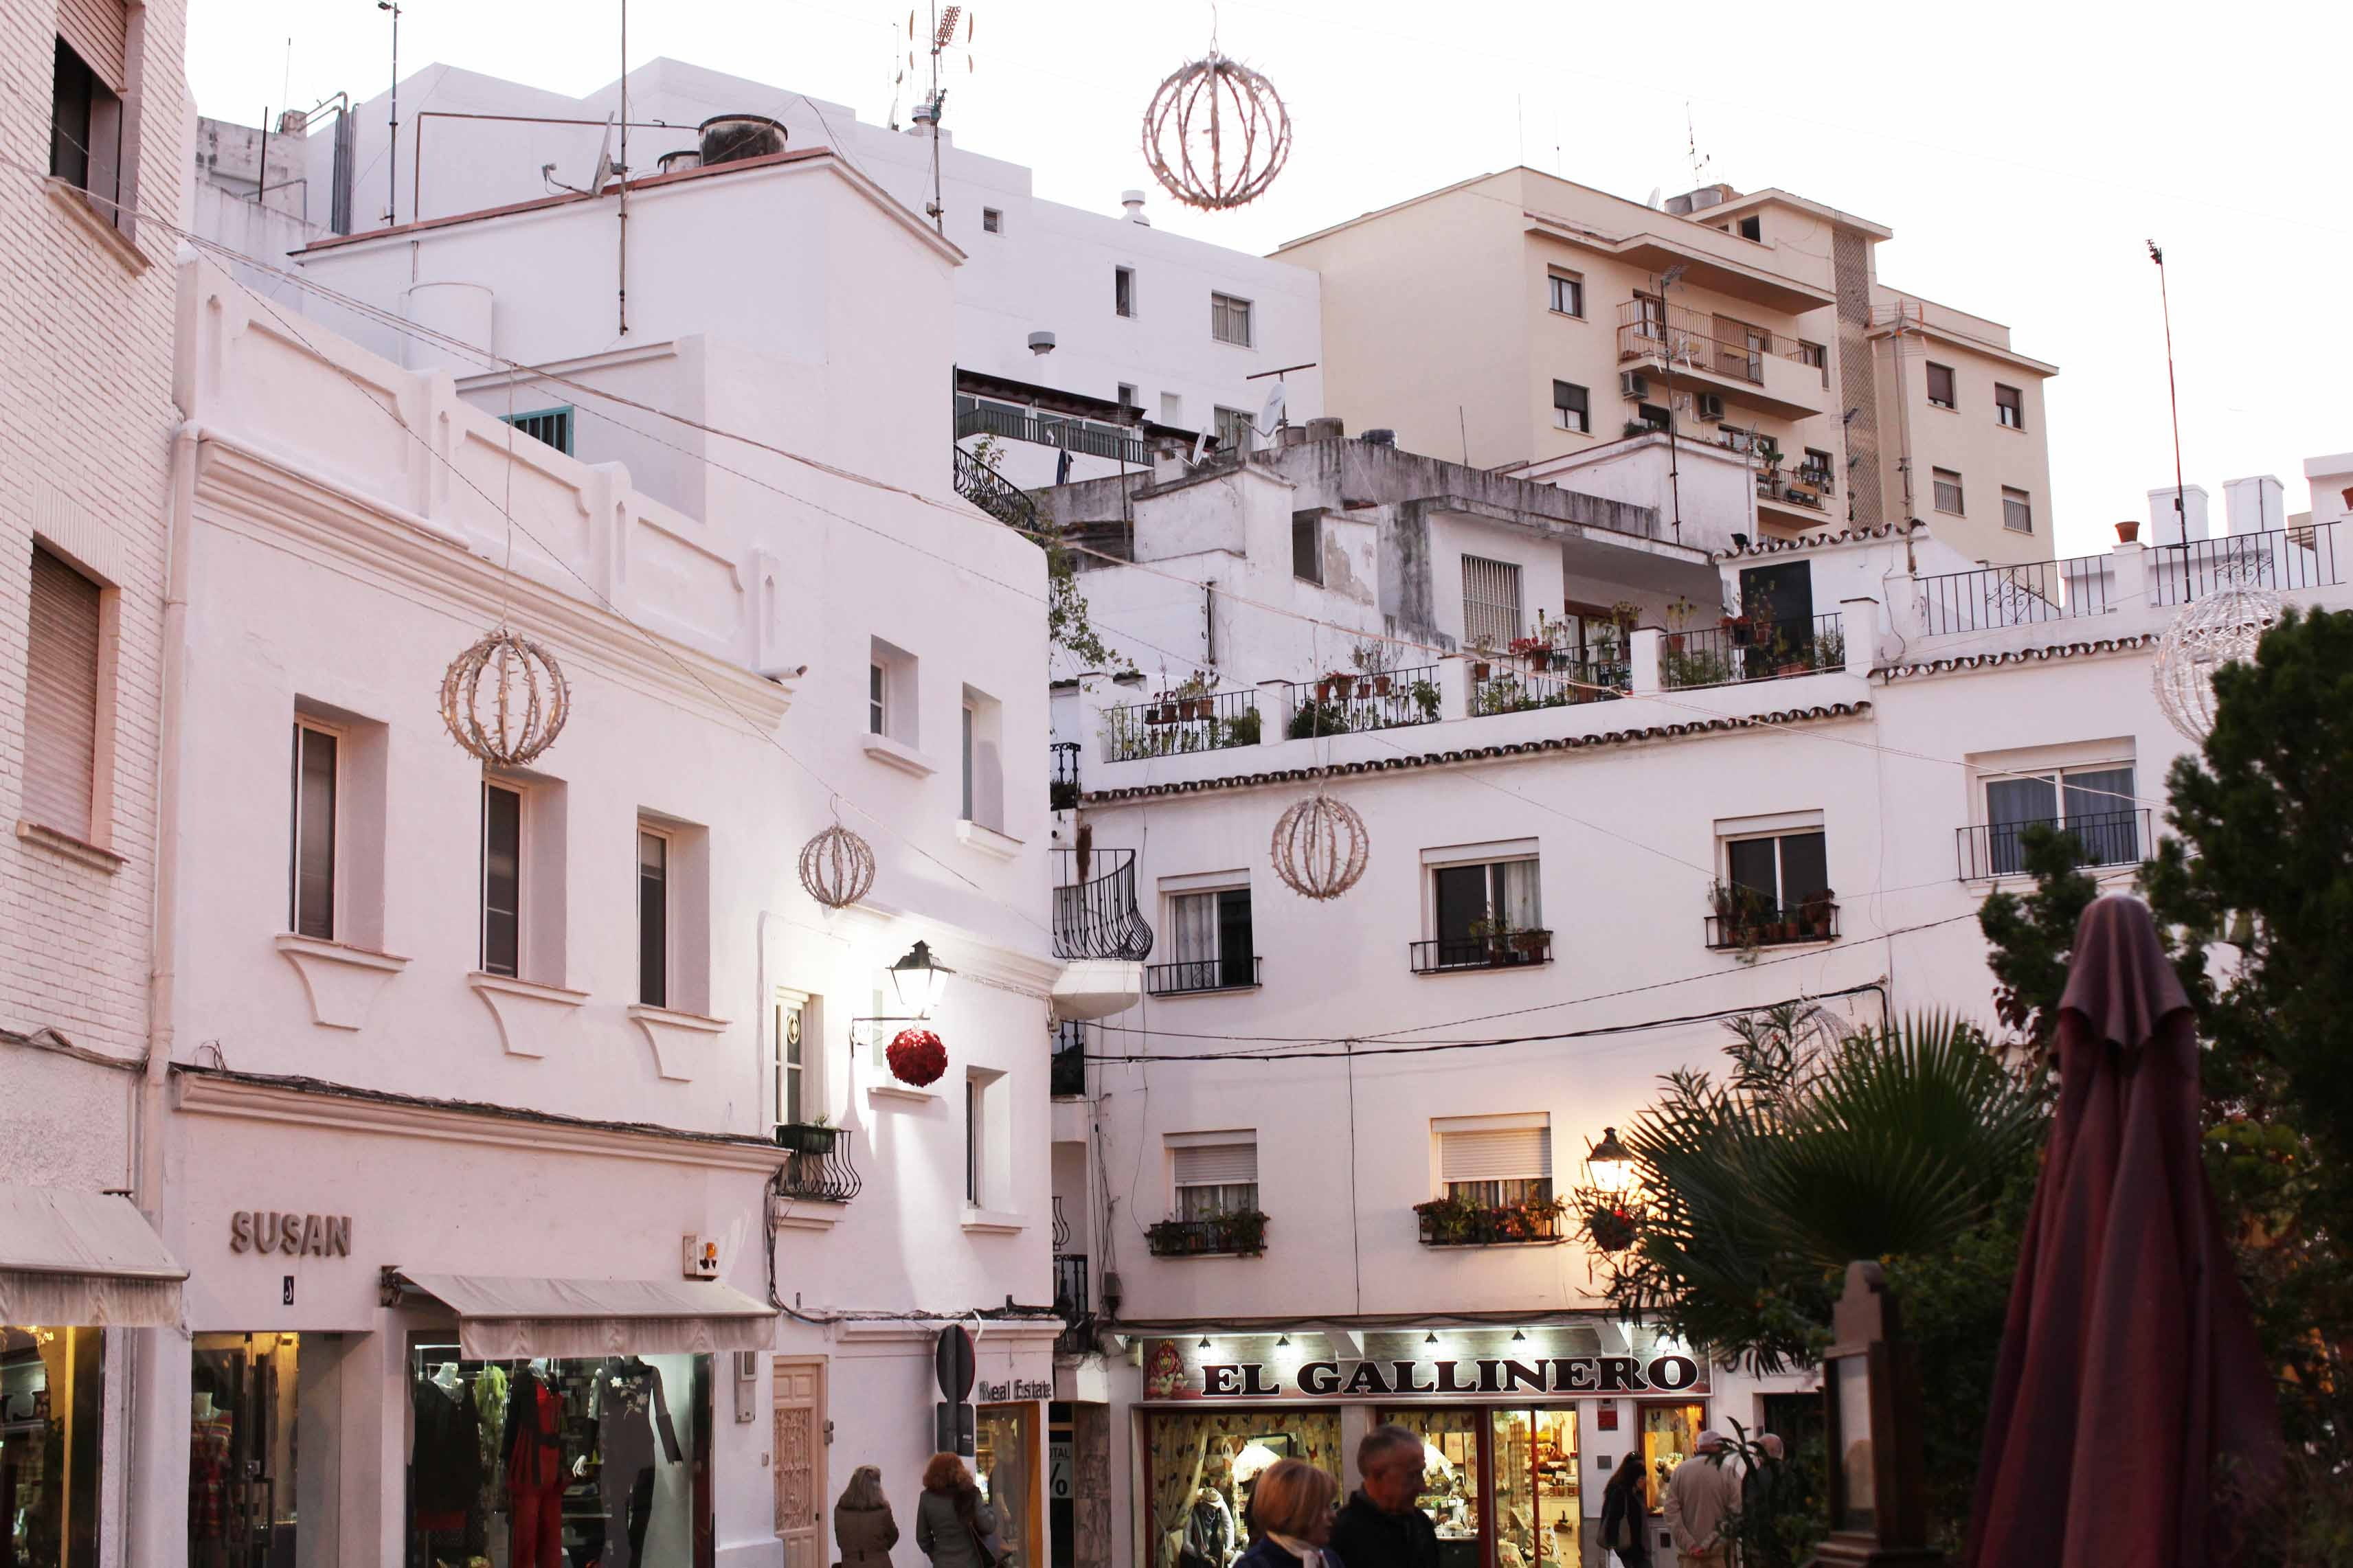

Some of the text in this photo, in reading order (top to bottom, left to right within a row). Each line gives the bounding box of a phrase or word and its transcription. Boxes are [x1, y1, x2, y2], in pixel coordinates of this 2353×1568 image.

[230, 1211, 352, 1257] SUSAN
[979, 1379, 1052, 1401] Real Estate
[1201, 1356, 1699, 1396] EL GALLINERO
